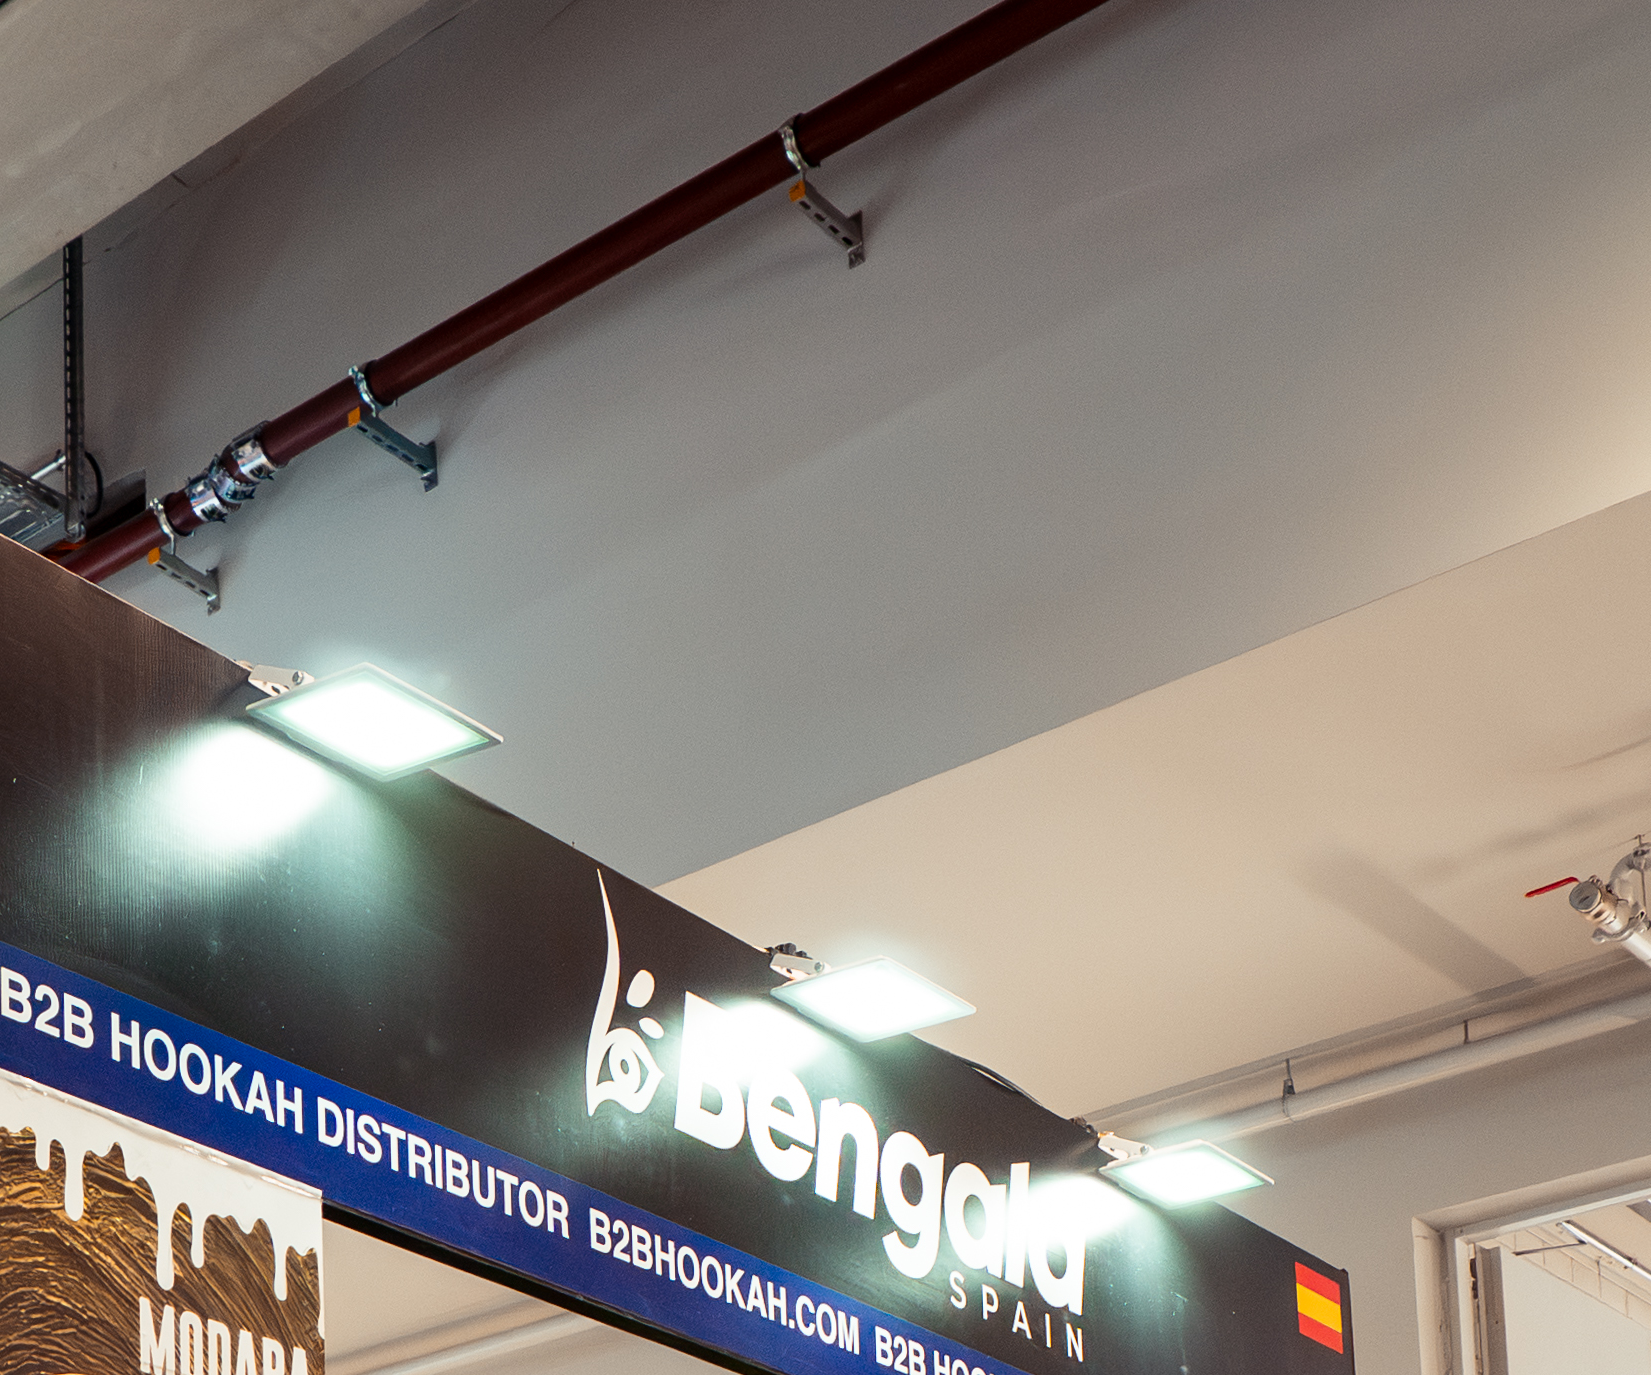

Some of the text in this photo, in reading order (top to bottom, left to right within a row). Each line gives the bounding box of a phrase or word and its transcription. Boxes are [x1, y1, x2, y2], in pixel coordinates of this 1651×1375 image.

[0, 966, 93, 1050] B2B
[110, 1012, 303, 1134] HOOKAH
[317, 1096, 569, 1238] DISTRIBUTOR
[589, 1208, 860, 1353] B2BHOOKAH.COM
[675, 991, 1086, 1315] Bengala
[950, 1270, 1083, 1361] SPAIN
